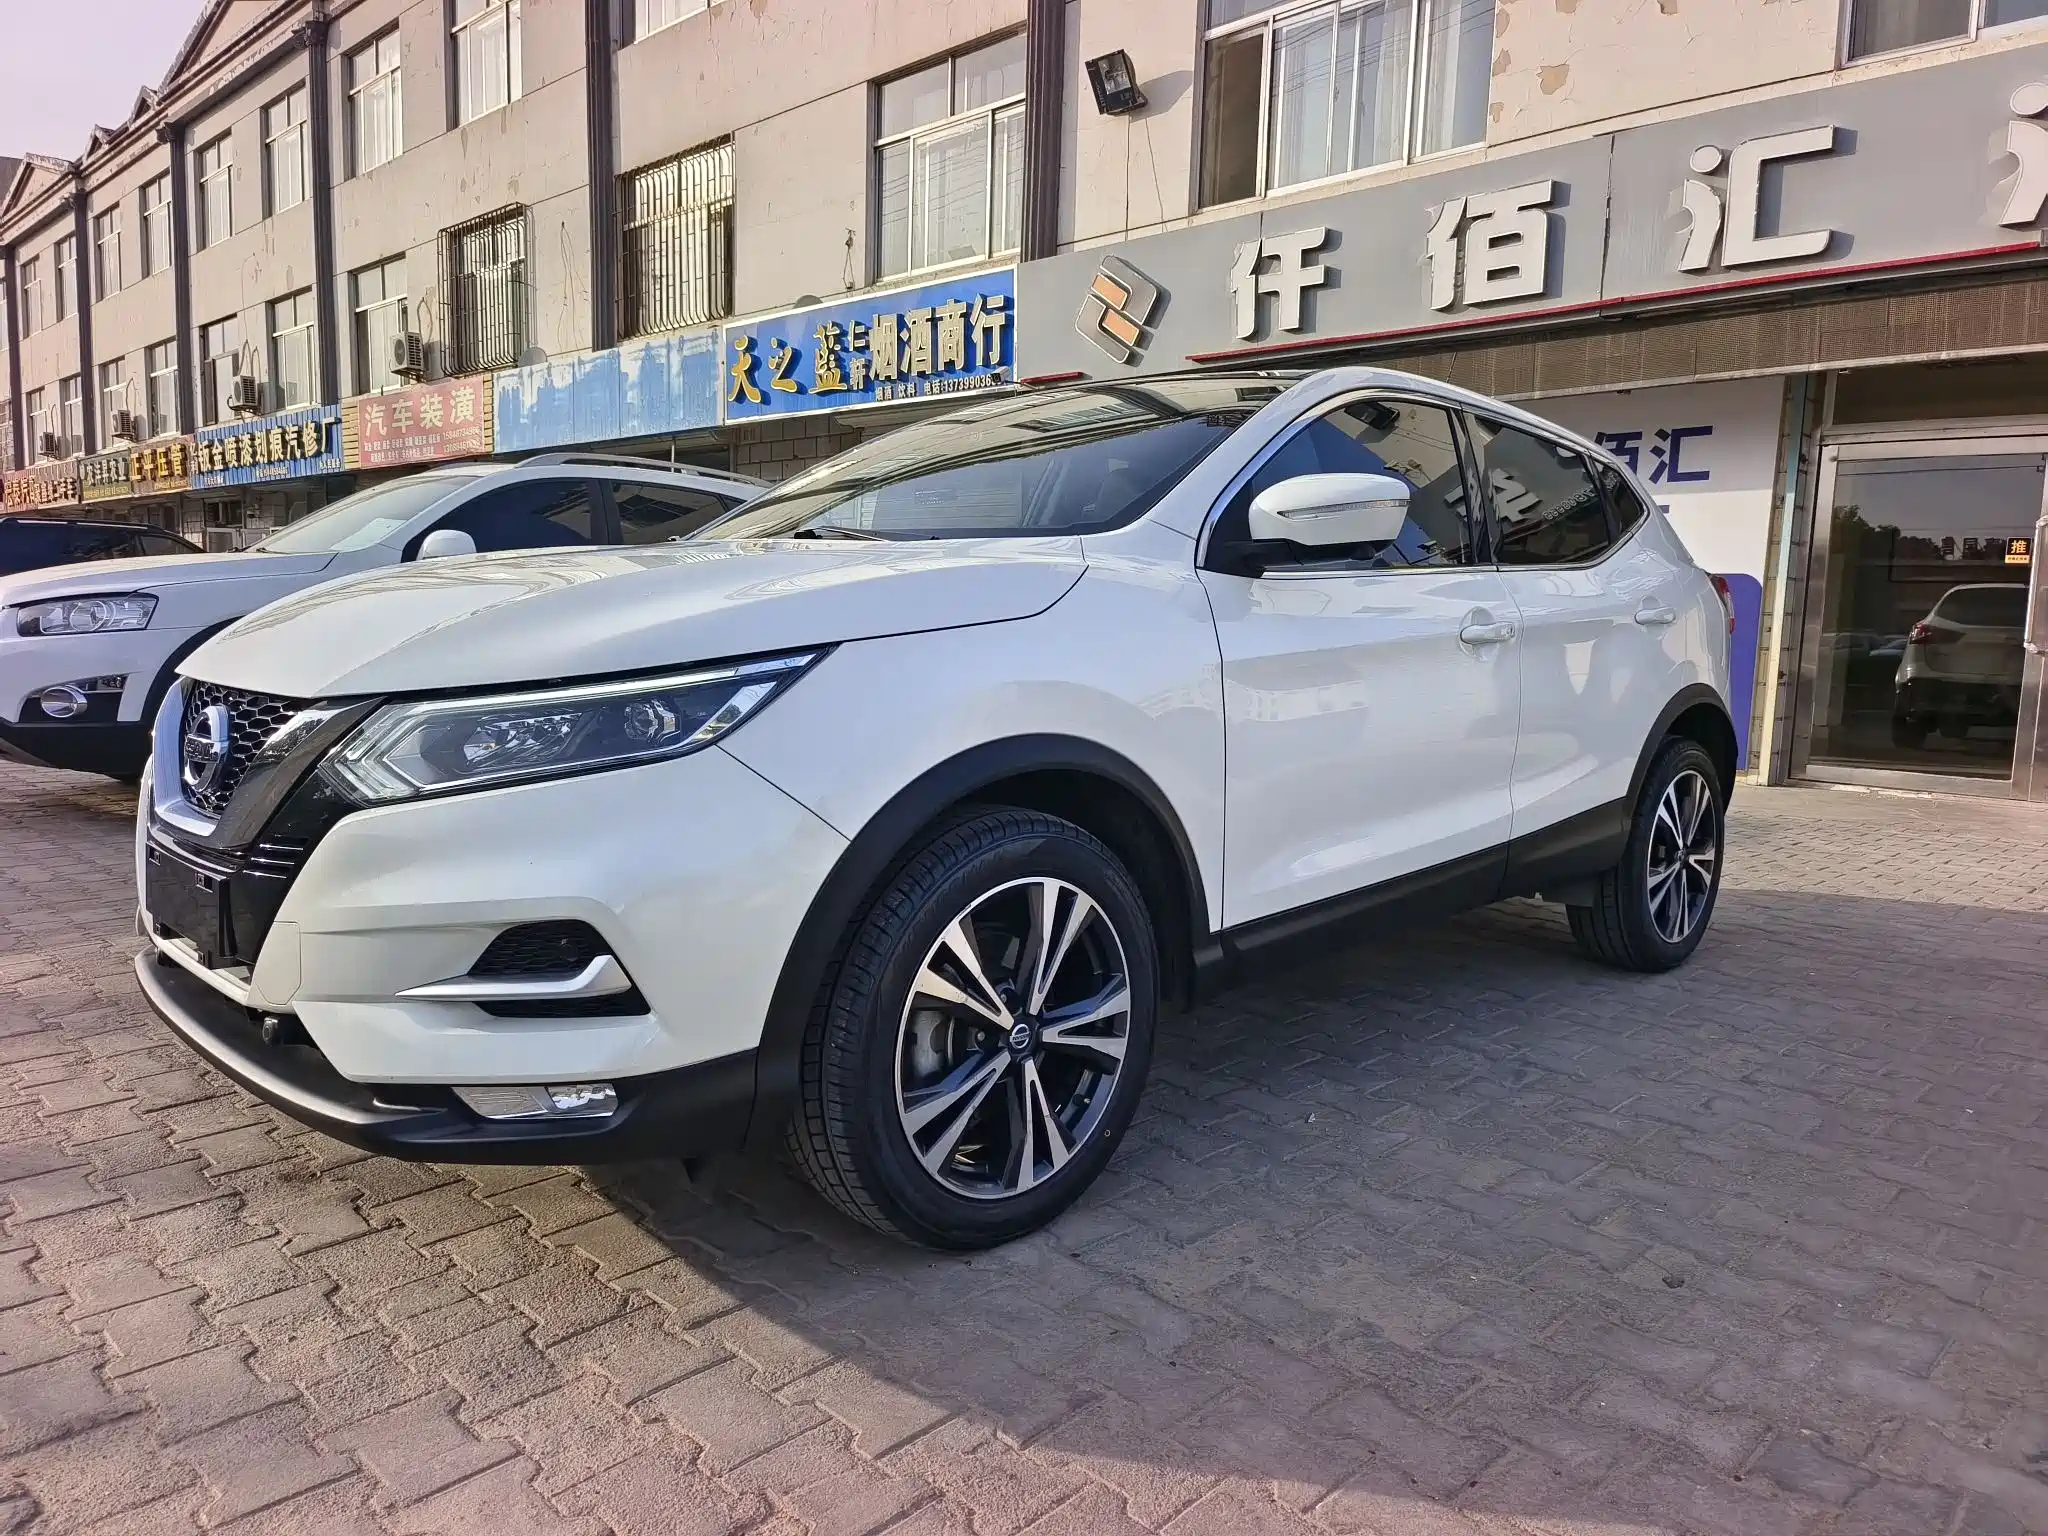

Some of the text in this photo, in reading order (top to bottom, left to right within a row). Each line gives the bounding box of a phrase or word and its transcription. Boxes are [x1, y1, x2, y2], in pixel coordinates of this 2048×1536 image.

[1231, 82, 2048, 340] 仟佰汇
[869, 294, 1006, 382] 烟酒商行
[365, 386, 476, 437] 汽车装潢
[875, 385, 893, 401] 烟酒
[898, 382, 915, 398] 饮料
[199, 416, 336, 472] 钣金喷漆划痕汽修厂
[2011, 540, 2027, 554] 推
